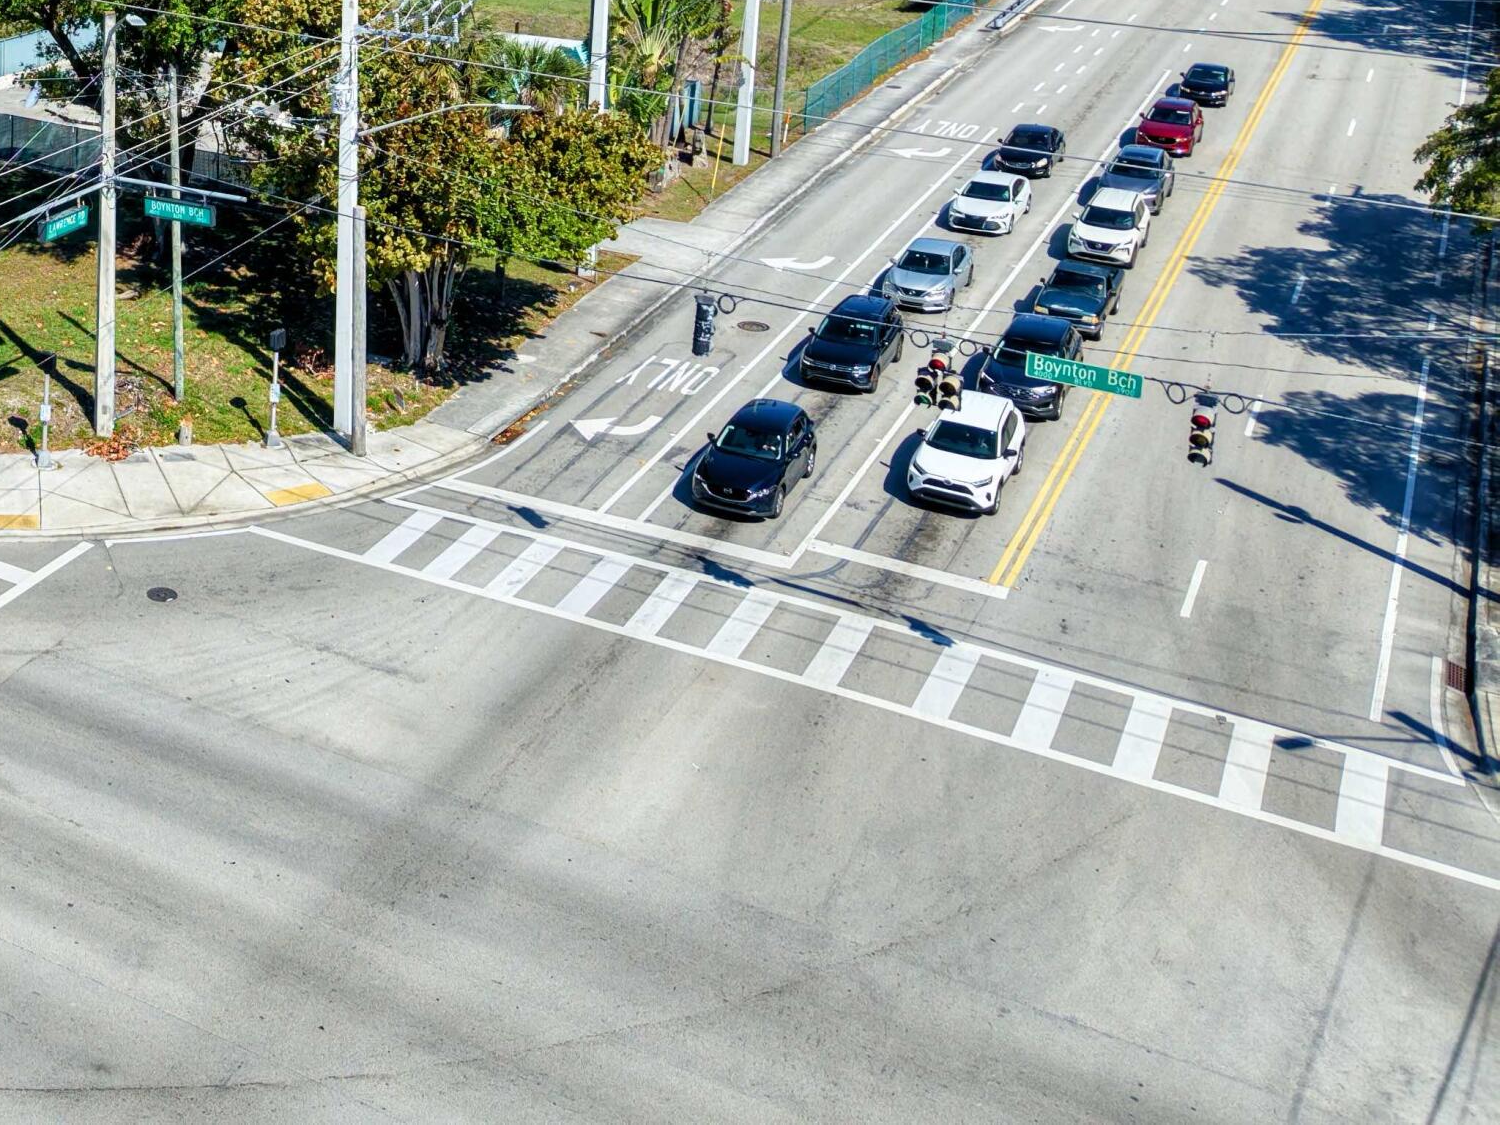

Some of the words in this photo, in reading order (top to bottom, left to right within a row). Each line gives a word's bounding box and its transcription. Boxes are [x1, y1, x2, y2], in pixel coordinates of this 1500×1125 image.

[911, 119, 980, 138] ONLY
[151, 200, 185, 214] BOYNTON
[188, 207, 204, 218] BCH
[49, 213, 77, 233] LAWRENCE
[615, 355, 720, 395] ONLY
[1033, 370, 1053, 379] 4000
[1074, 378, 1093, 387] BLVD
[1034, 355, 1096, 382] Boynton
[1107, 370, 1137, 389] Bch
